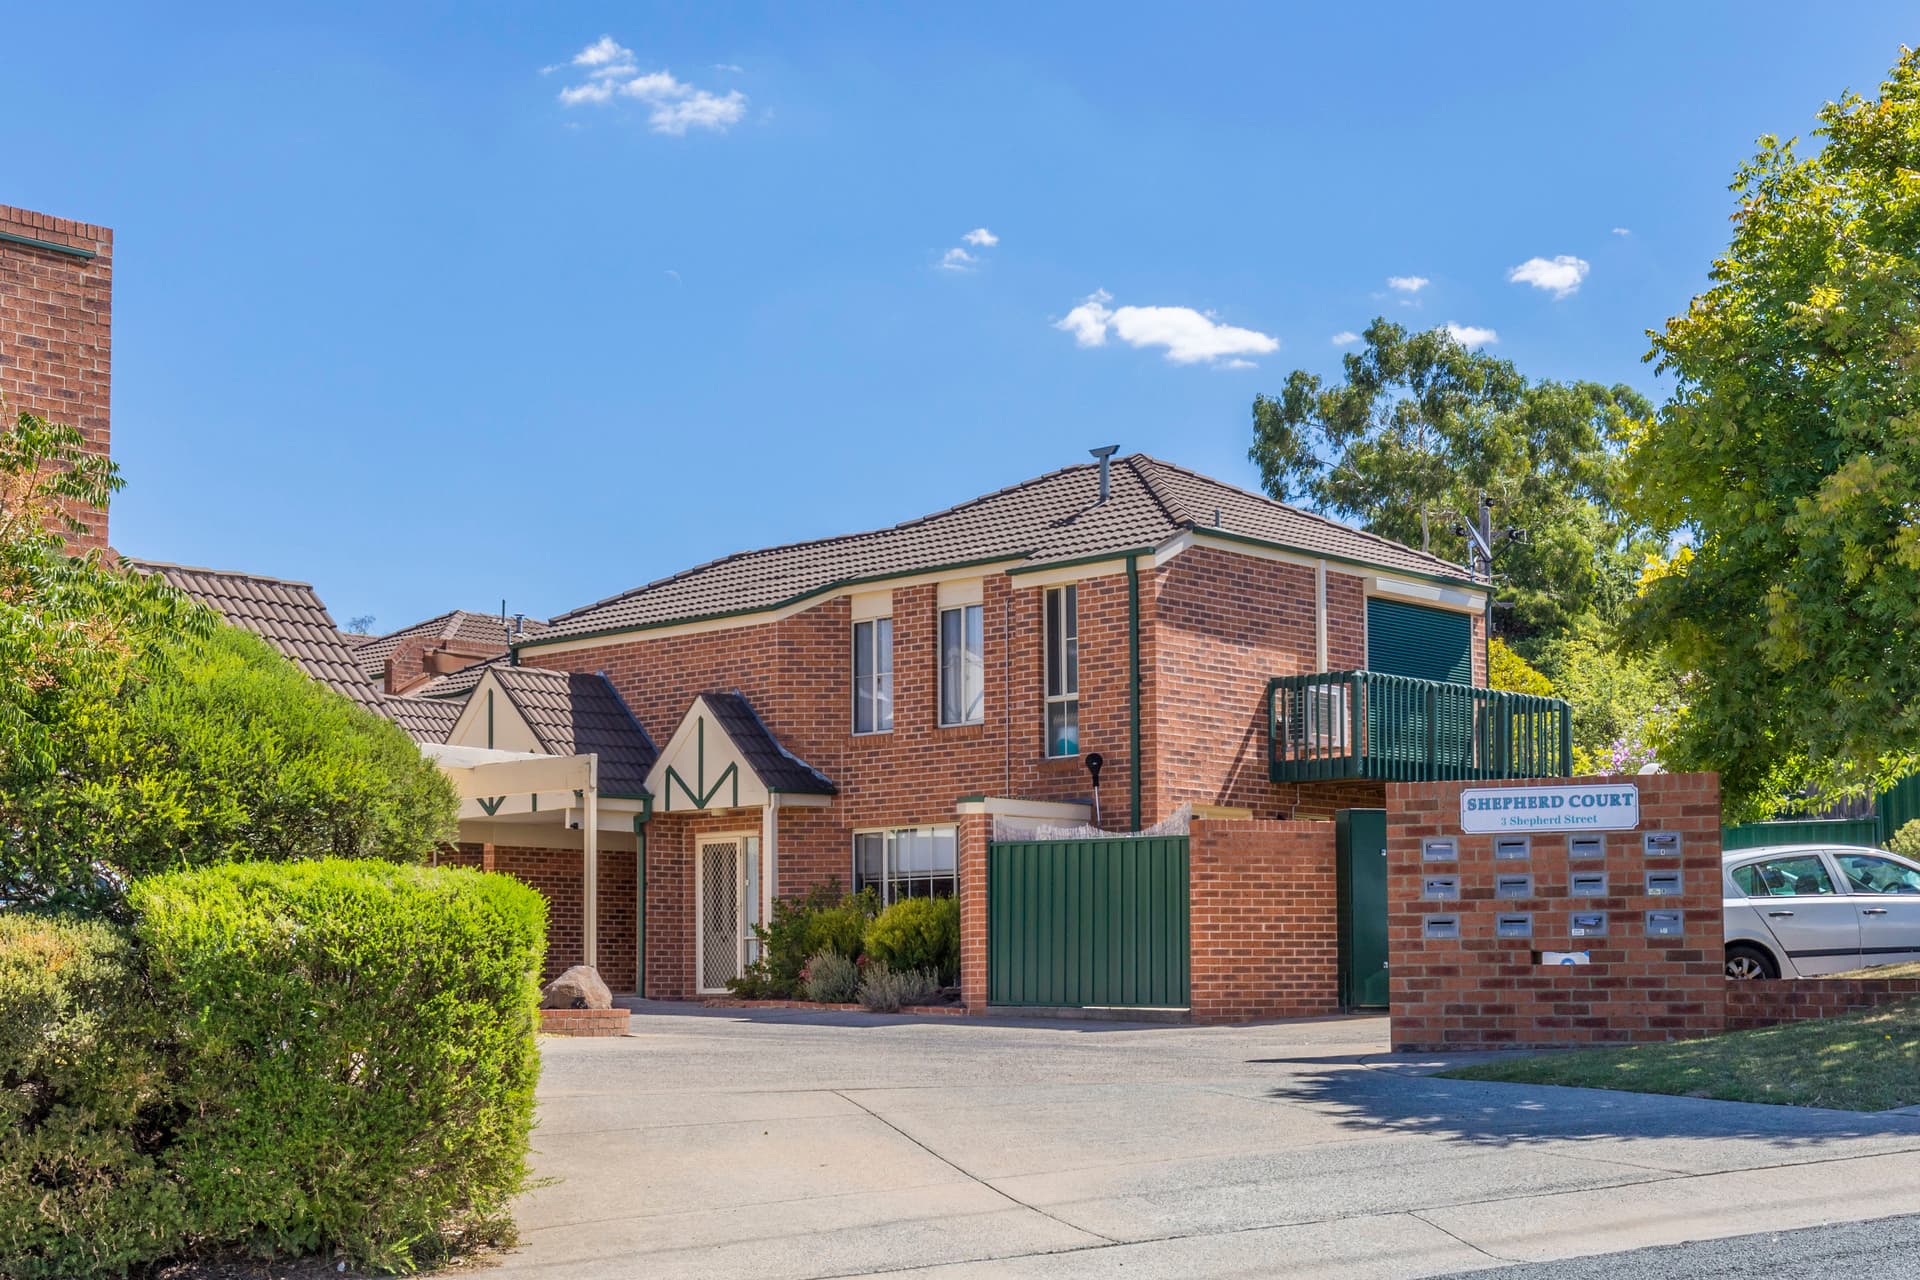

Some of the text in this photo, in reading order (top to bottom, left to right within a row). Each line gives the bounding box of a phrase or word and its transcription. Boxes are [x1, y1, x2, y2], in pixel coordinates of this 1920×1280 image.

[1467, 792, 1633, 811] SHEPHERD COURT
[1501, 814, 1598, 827] 3 Shepherd Street
